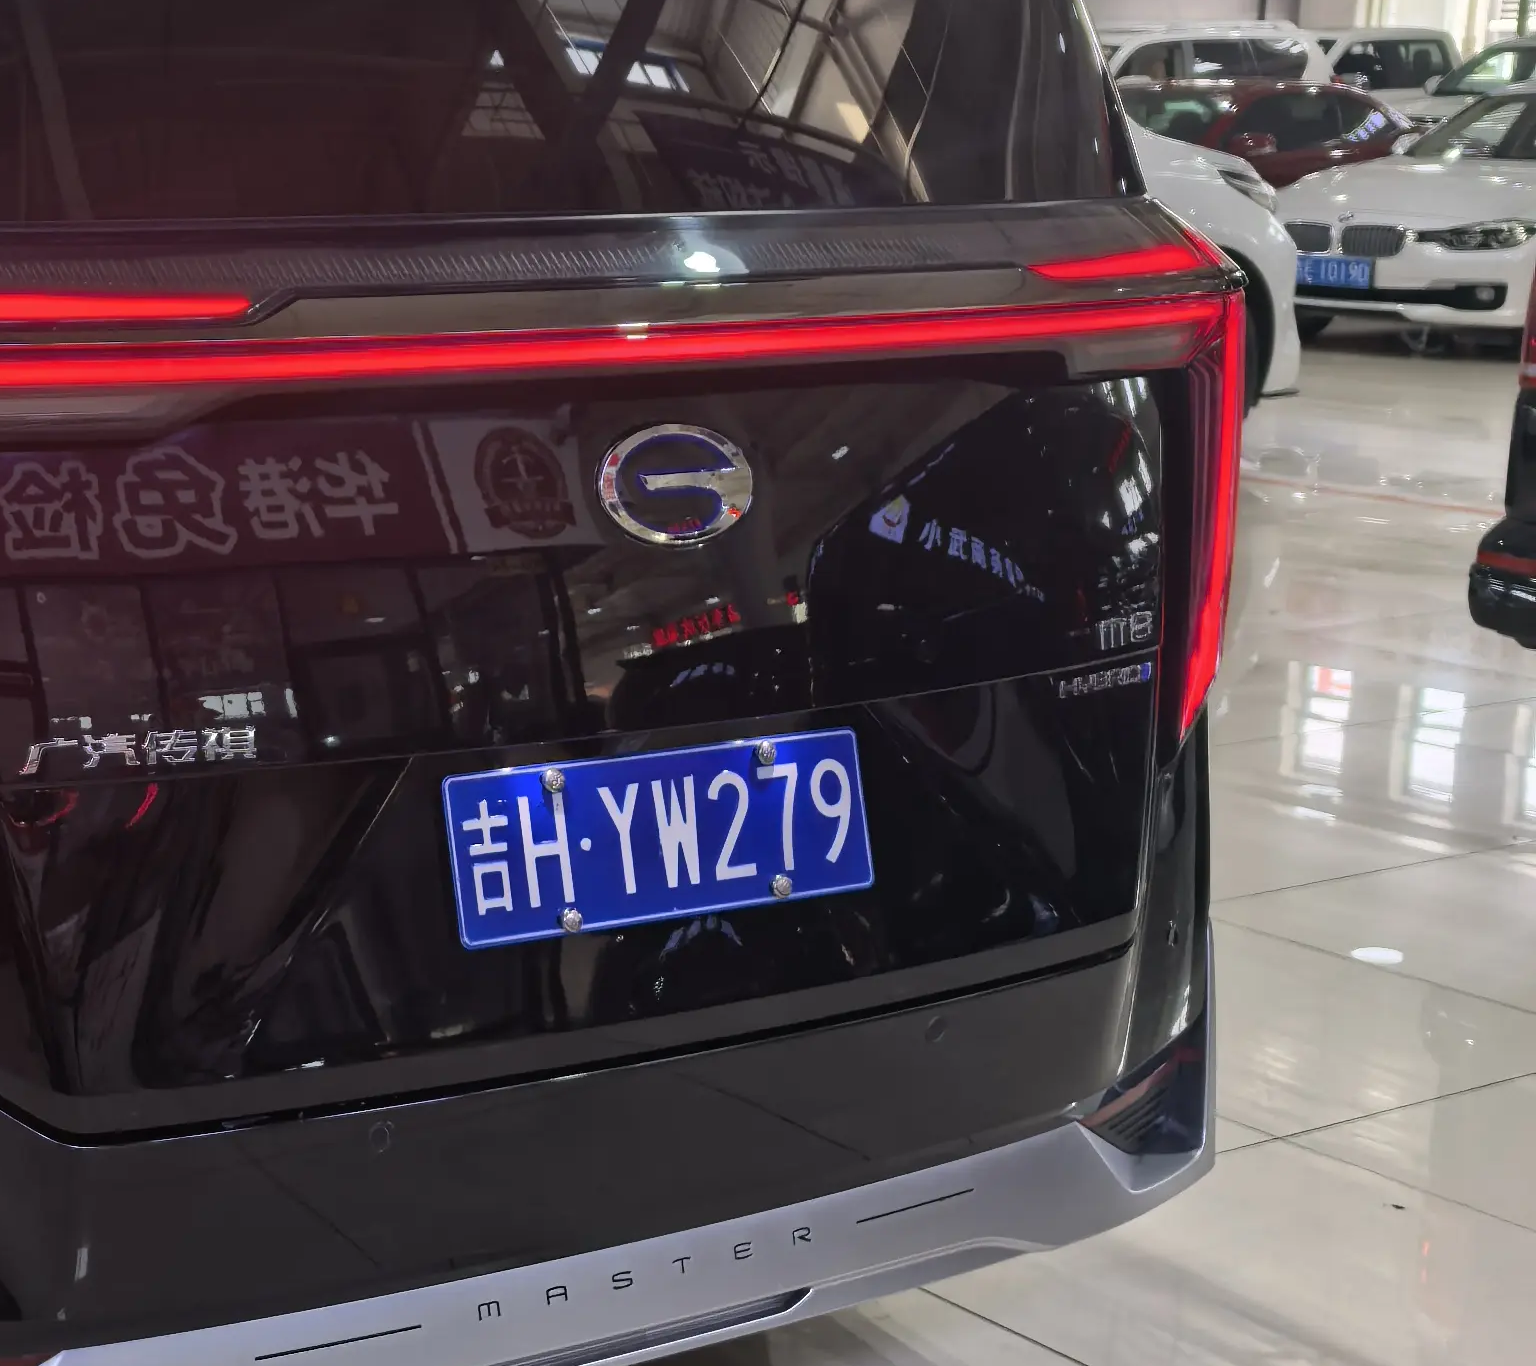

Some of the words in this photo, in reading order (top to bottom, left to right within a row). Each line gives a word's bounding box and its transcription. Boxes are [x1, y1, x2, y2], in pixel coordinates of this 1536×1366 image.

[18, 725, 257, 776] 广汽传祺
[478, 1227, 812, 1321] MASTER
